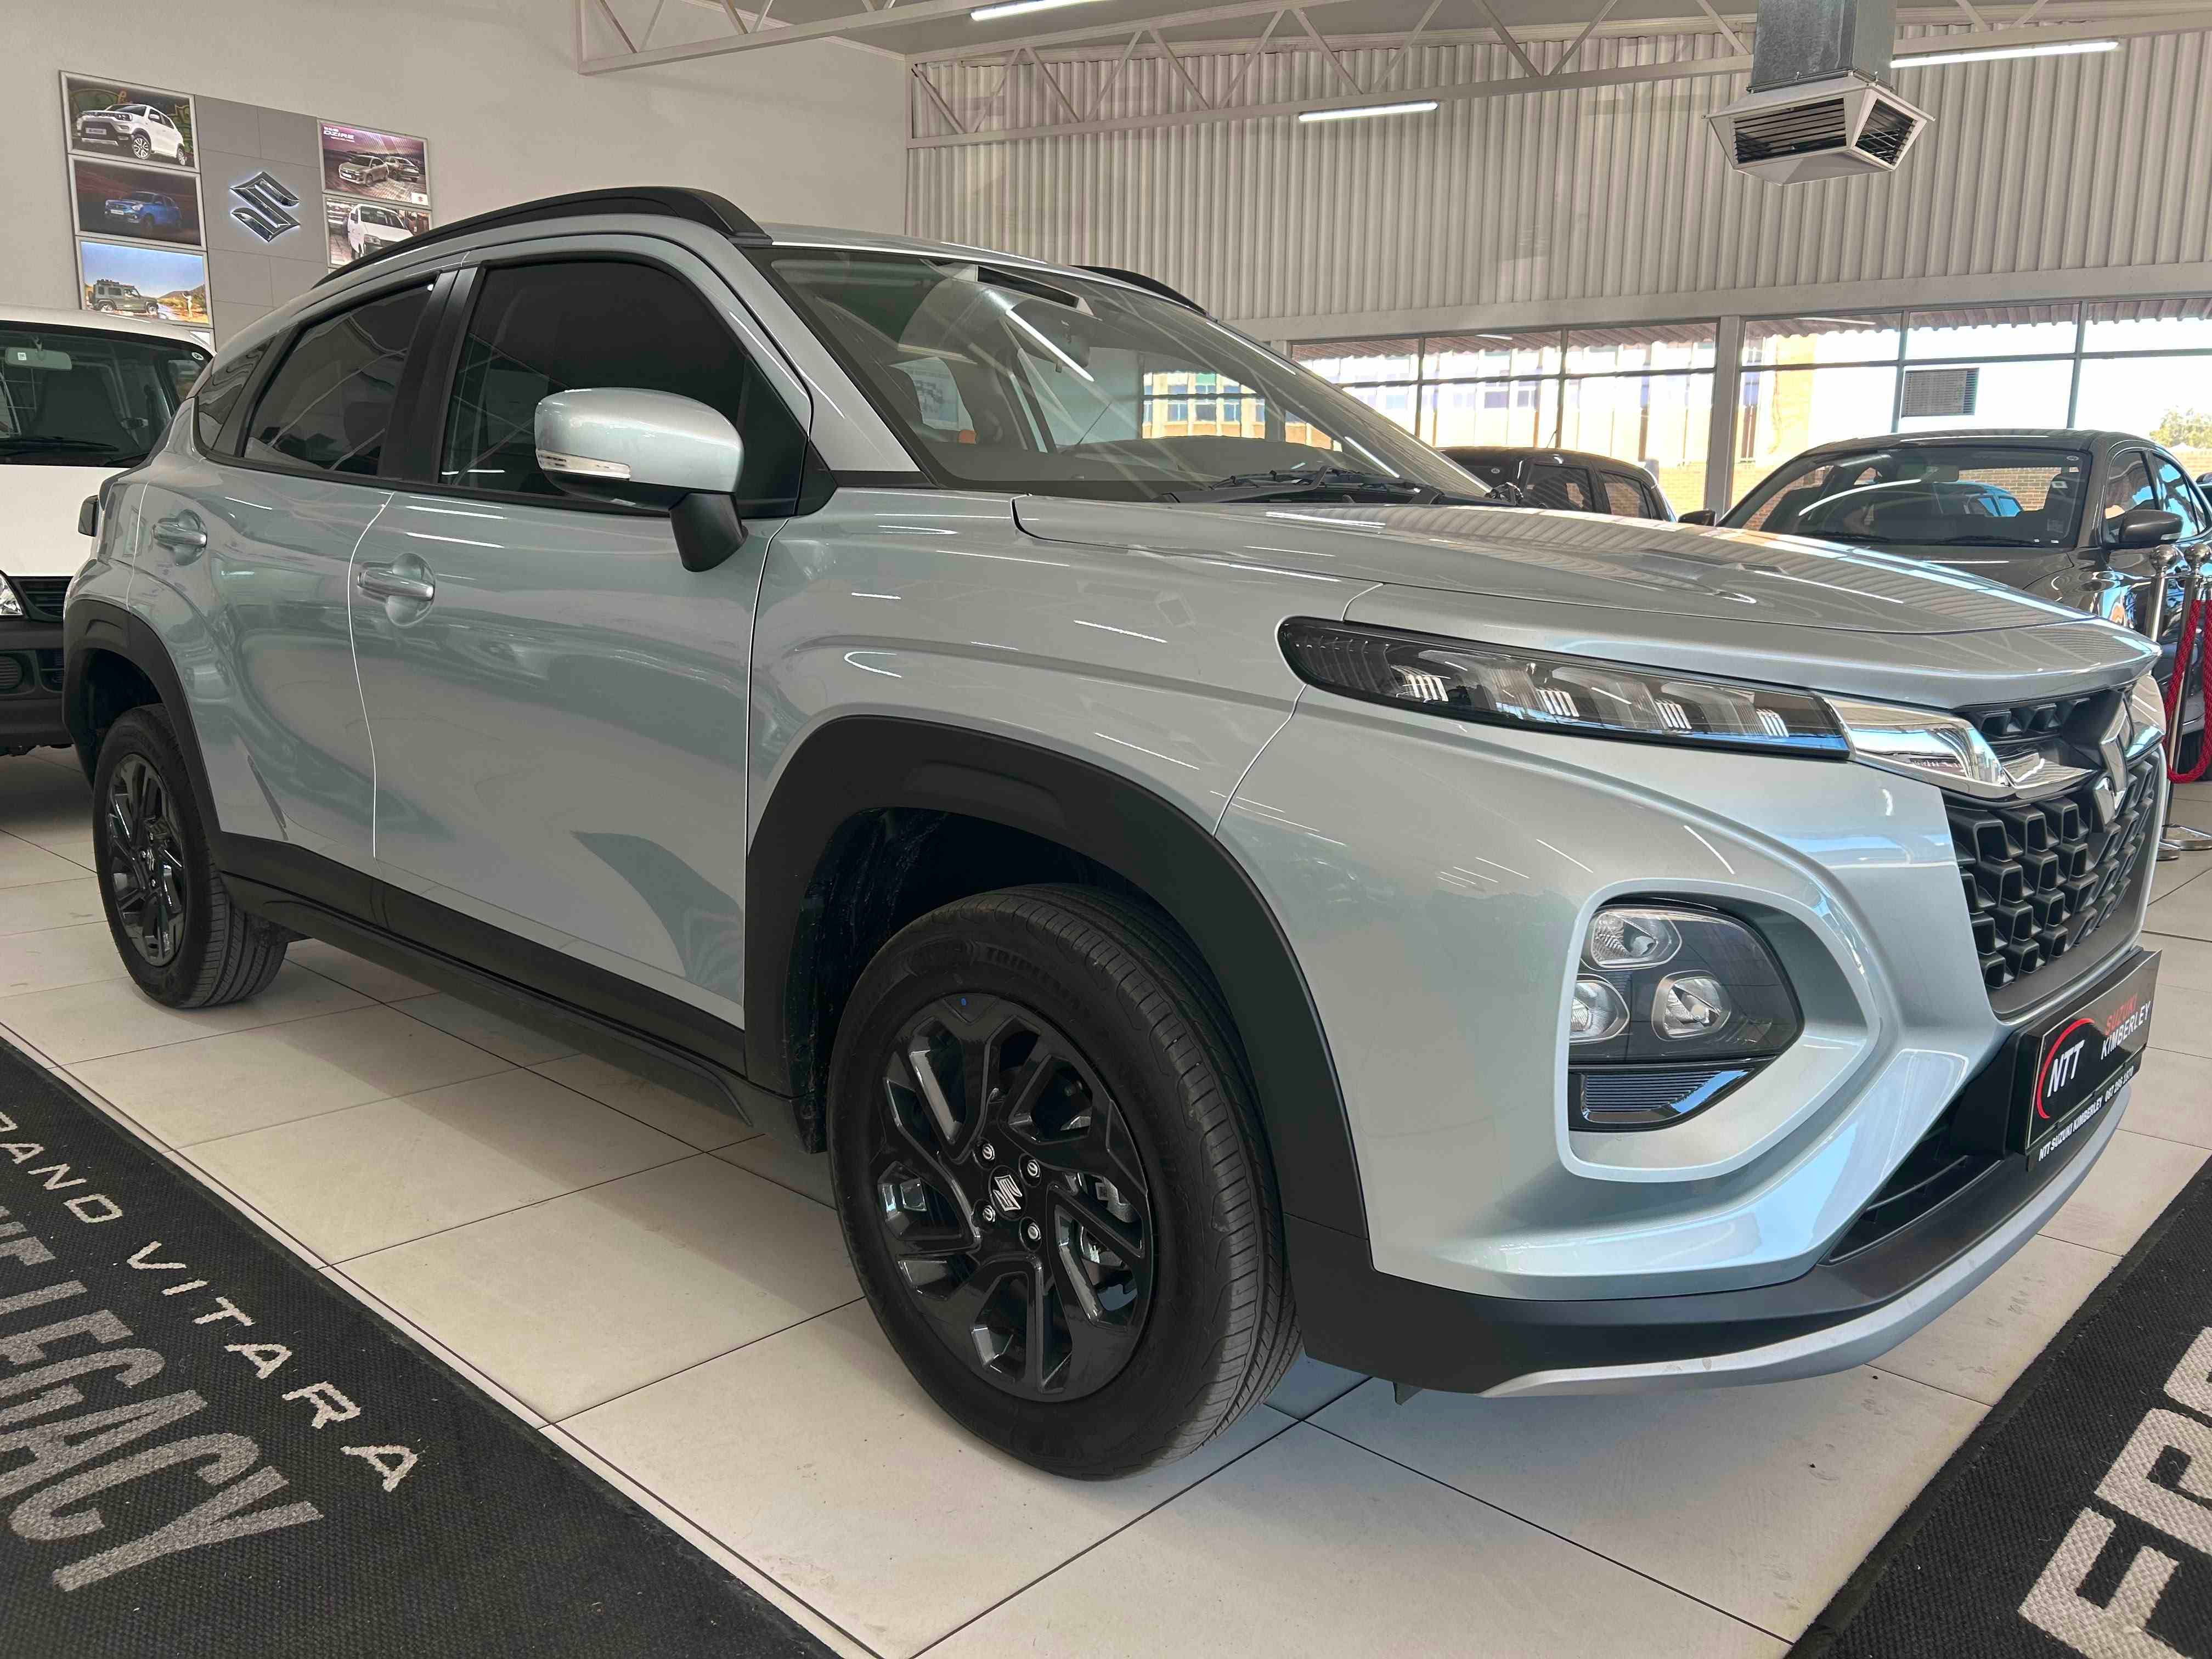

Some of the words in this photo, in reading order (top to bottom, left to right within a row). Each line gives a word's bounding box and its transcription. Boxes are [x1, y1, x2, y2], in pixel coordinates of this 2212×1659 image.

[2100, 1000, 2151, 1060] KIMBERLEY
[2104, 994, 2137, 1036] SUZUKI
[2047, 1040, 2085, 1098] NTT
[2039, 1141, 2051, 1162] NTT
[2051, 1122, 2073, 1151] SUZUKI
[2073, 1095, 2103, 1132] KIMBERLEY
[126, 1240, 419, 1492] VITARA
